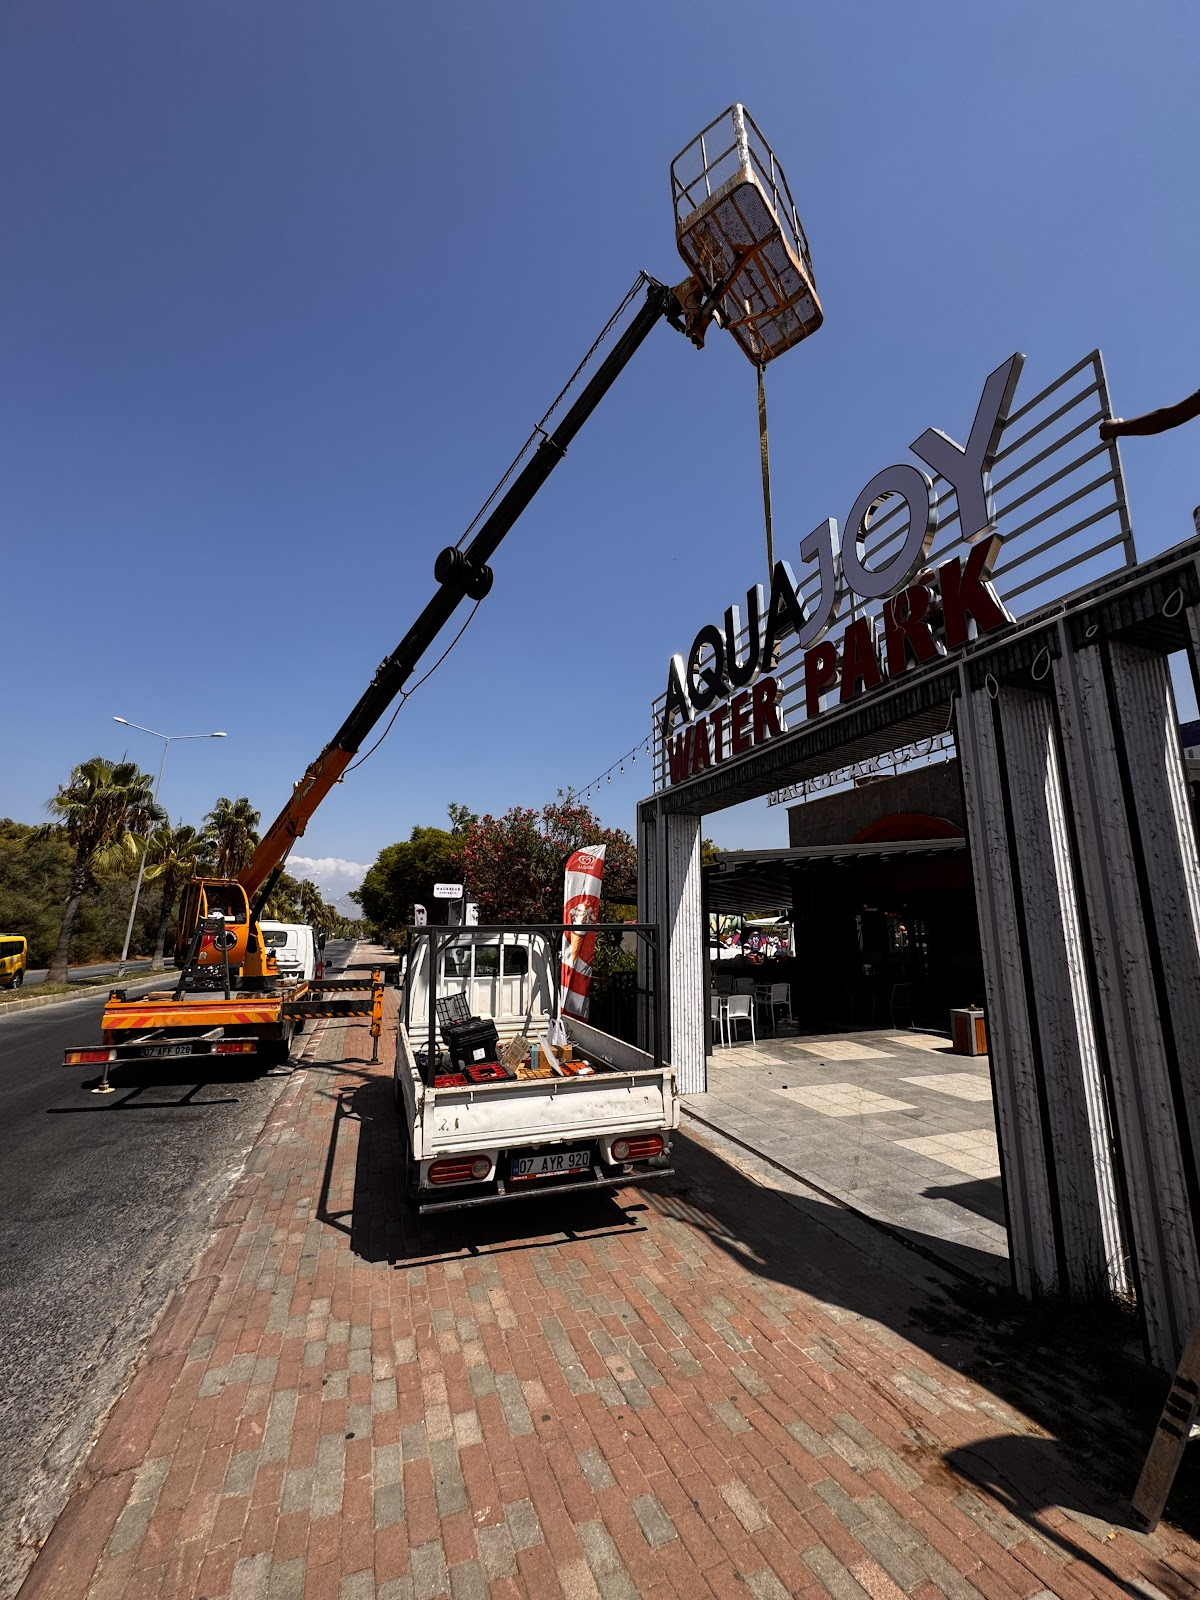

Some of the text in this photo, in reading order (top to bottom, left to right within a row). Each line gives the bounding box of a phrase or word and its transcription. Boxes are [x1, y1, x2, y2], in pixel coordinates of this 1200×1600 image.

[667, 533, 1016, 784] WATER PARK
[519, 1152, 589, 1173] 07 AYR 920
